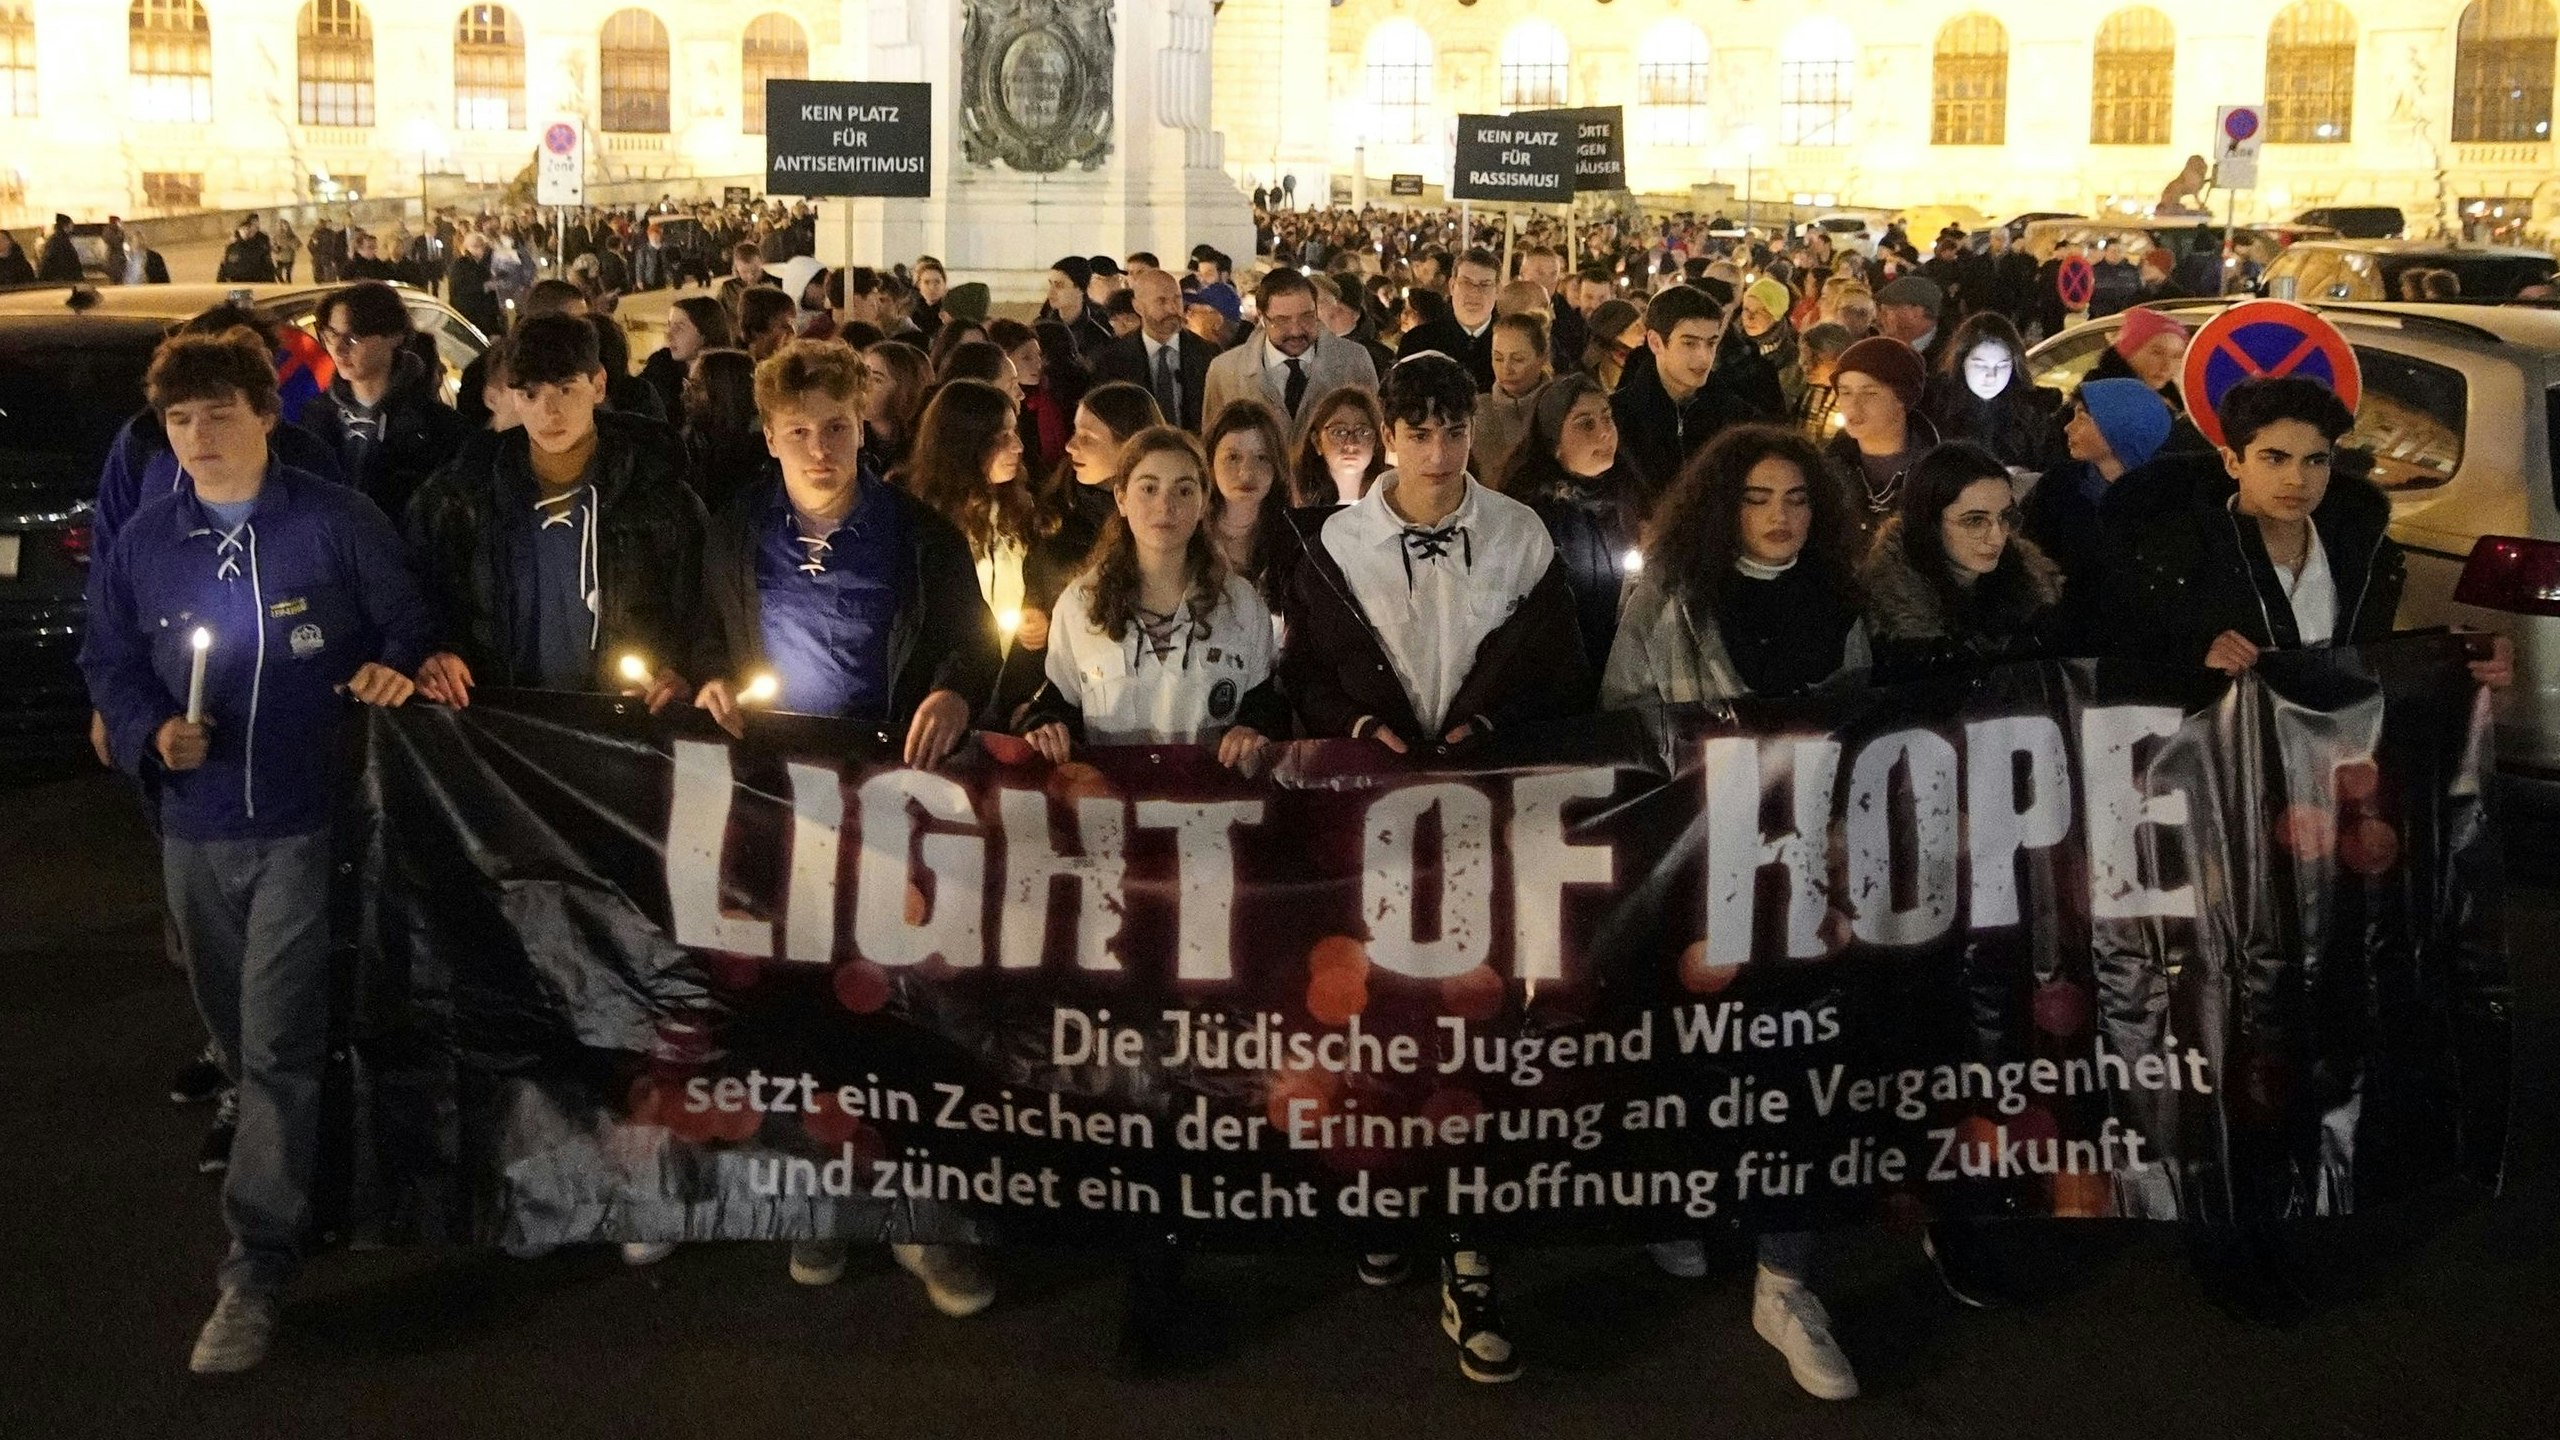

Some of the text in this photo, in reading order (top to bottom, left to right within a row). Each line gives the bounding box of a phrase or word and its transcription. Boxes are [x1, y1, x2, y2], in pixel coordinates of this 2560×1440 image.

[801, 104, 899, 122] KEIN PLATZ
[833, 127, 868, 148] FÜR
[1477, 129, 1559, 146] KEIN PLATZ
[1501, 149, 1531, 167] FÜR
[1577, 143, 1607, 156] GEN
[773, 155, 925, 173] ANTISEMITIMUS!
[1469, 171, 1560, 188] RASSISMUS!
[666, 705, 2197, 980] LIGHT OF HOPE
[1052, 1002, 1840, 1086] Die Jüdische Jugend Wiens
[684, 1034, 2213, 1151] setzt ein Zeichen der Erinnerung an die Vergangenheit
[748, 1117, 2150, 1220] und zündet ein Licht der Hoffnung für die Zukunft
